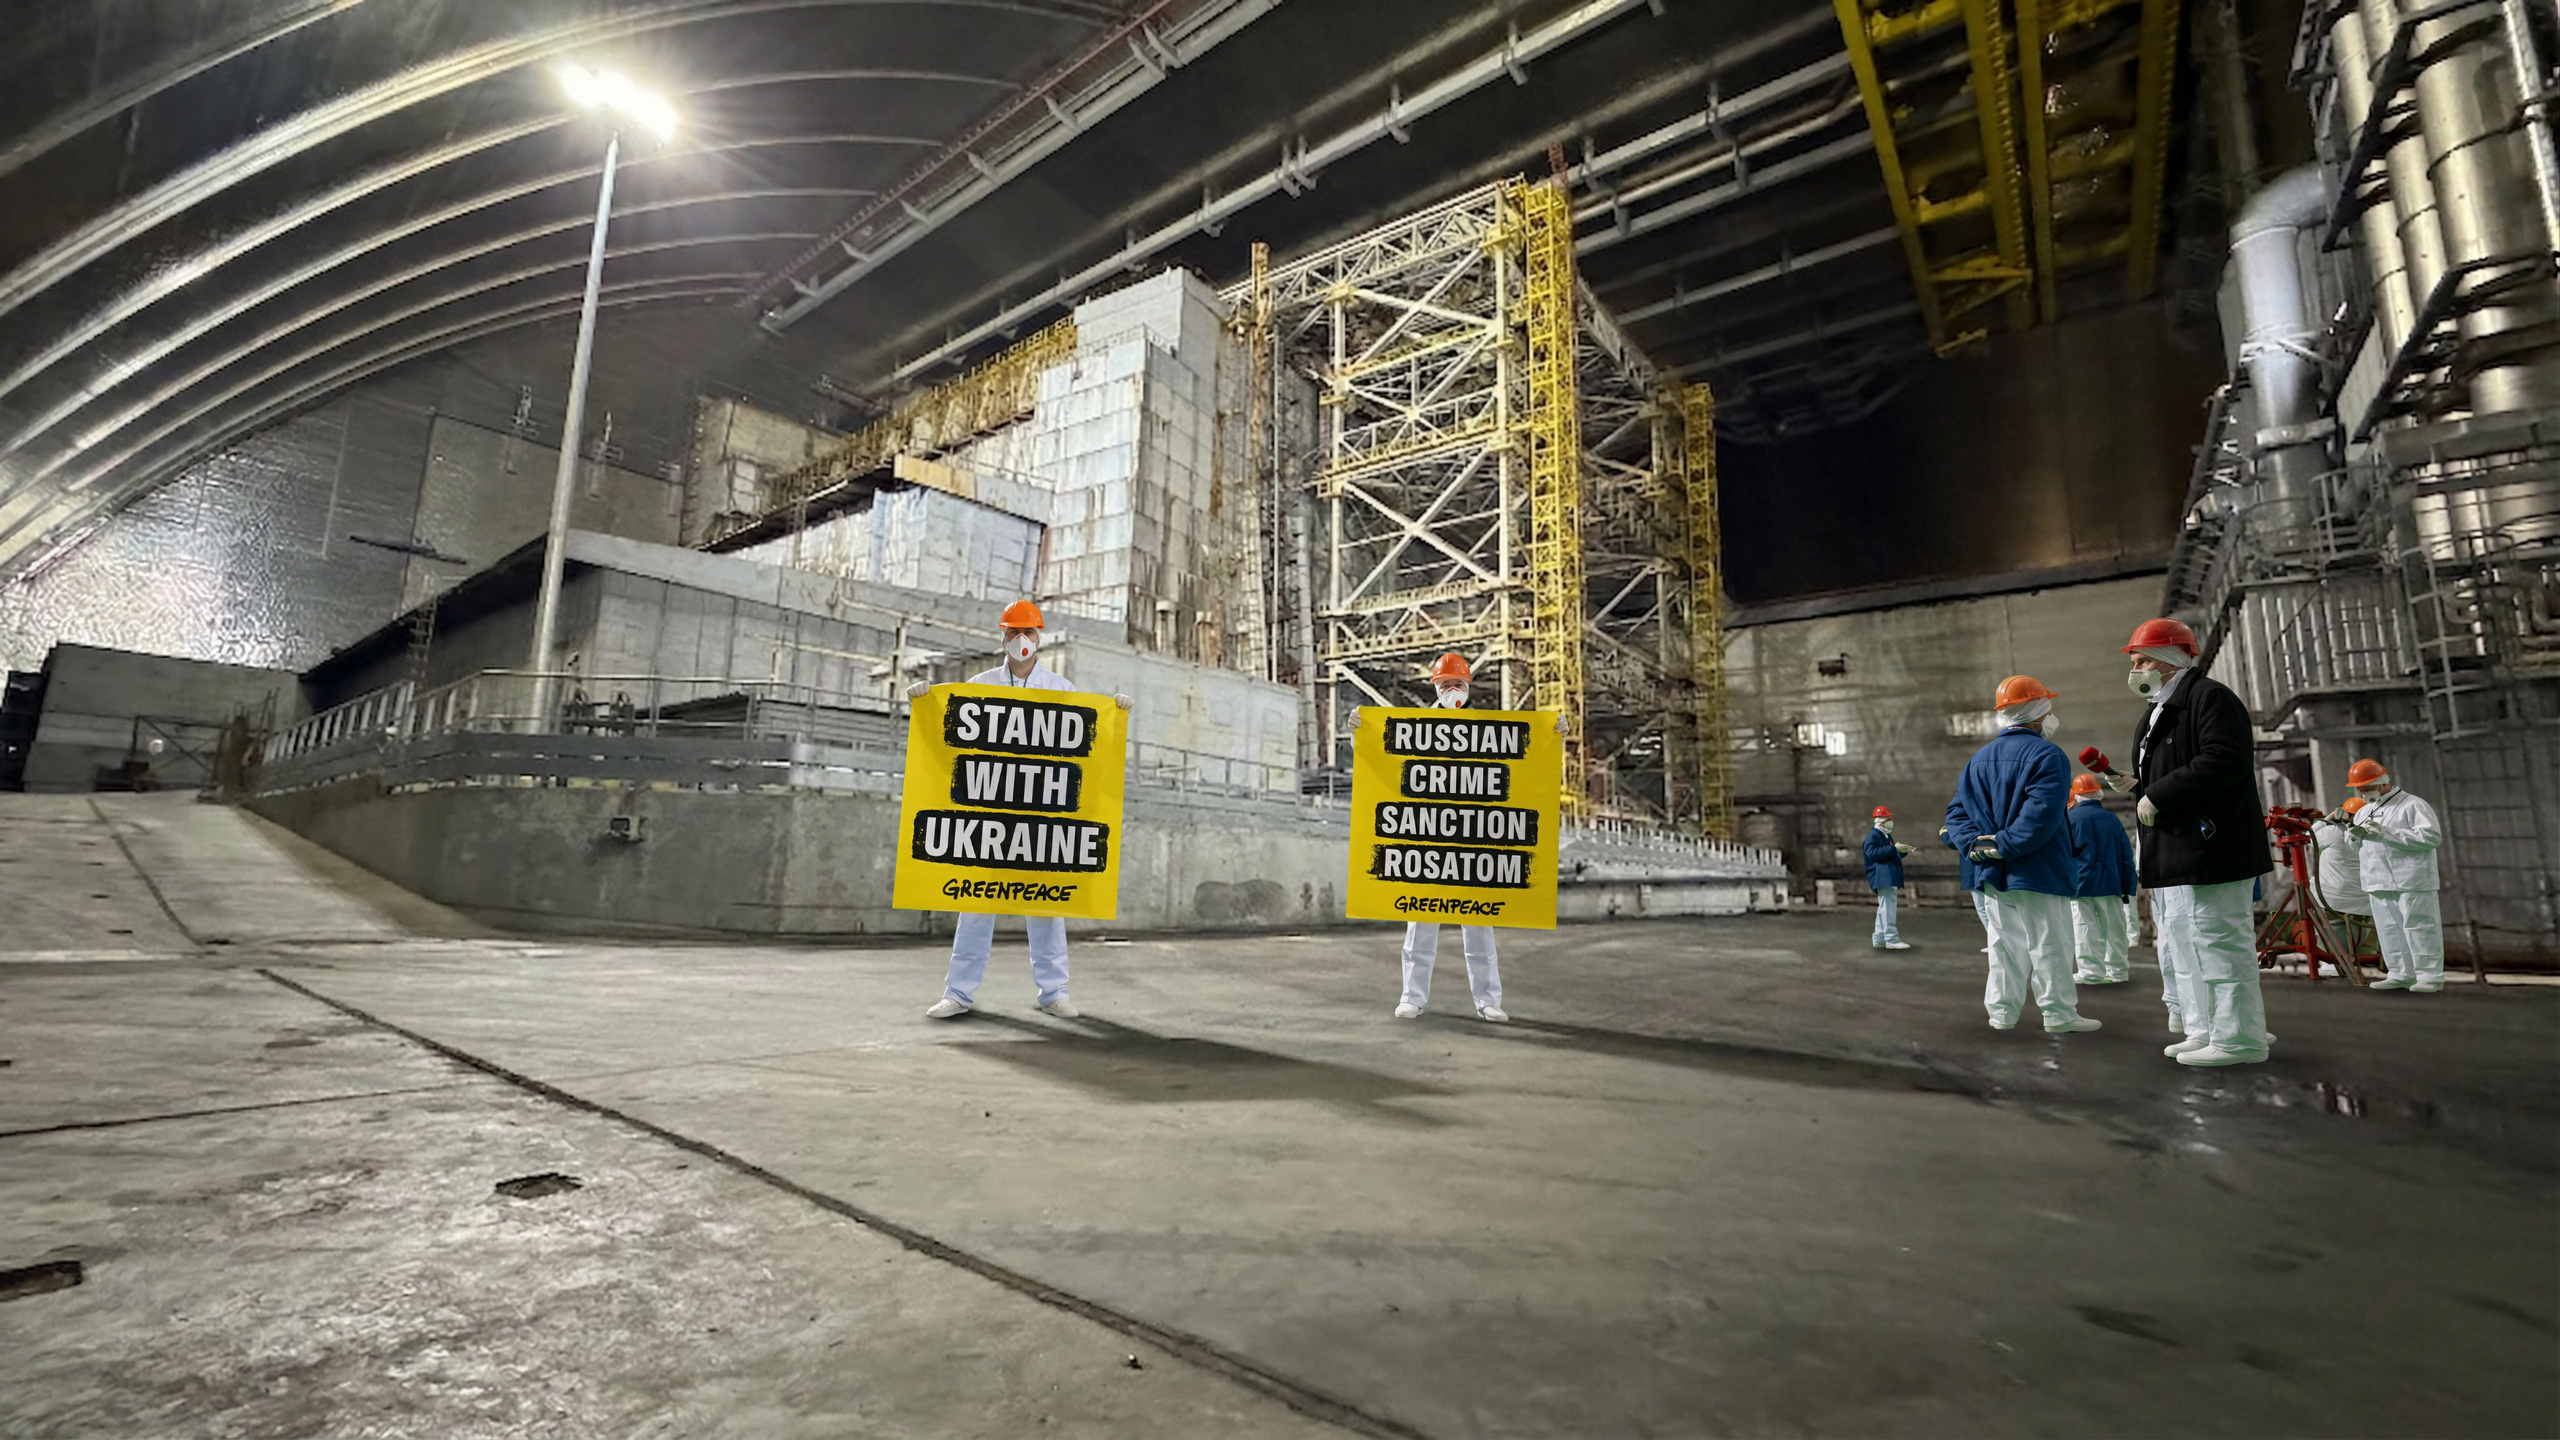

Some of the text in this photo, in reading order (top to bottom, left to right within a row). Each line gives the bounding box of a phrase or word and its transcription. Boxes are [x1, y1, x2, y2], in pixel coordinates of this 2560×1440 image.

[957, 702, 1084, 749] STAND
[1395, 722, 1519, 754] RUSSIAN
[965, 760, 1069, 806] WITH
[1409, 764, 1502, 796] CRIME
[1381, 805, 1526, 840] SANCTION
[924, 816, 1100, 866] UKRAINE
[1384, 848, 1521, 884] ROSATOM
[942, 878, 1078, 902] GREENPEACE
[1394, 895, 1506, 916] GREENPEACE
